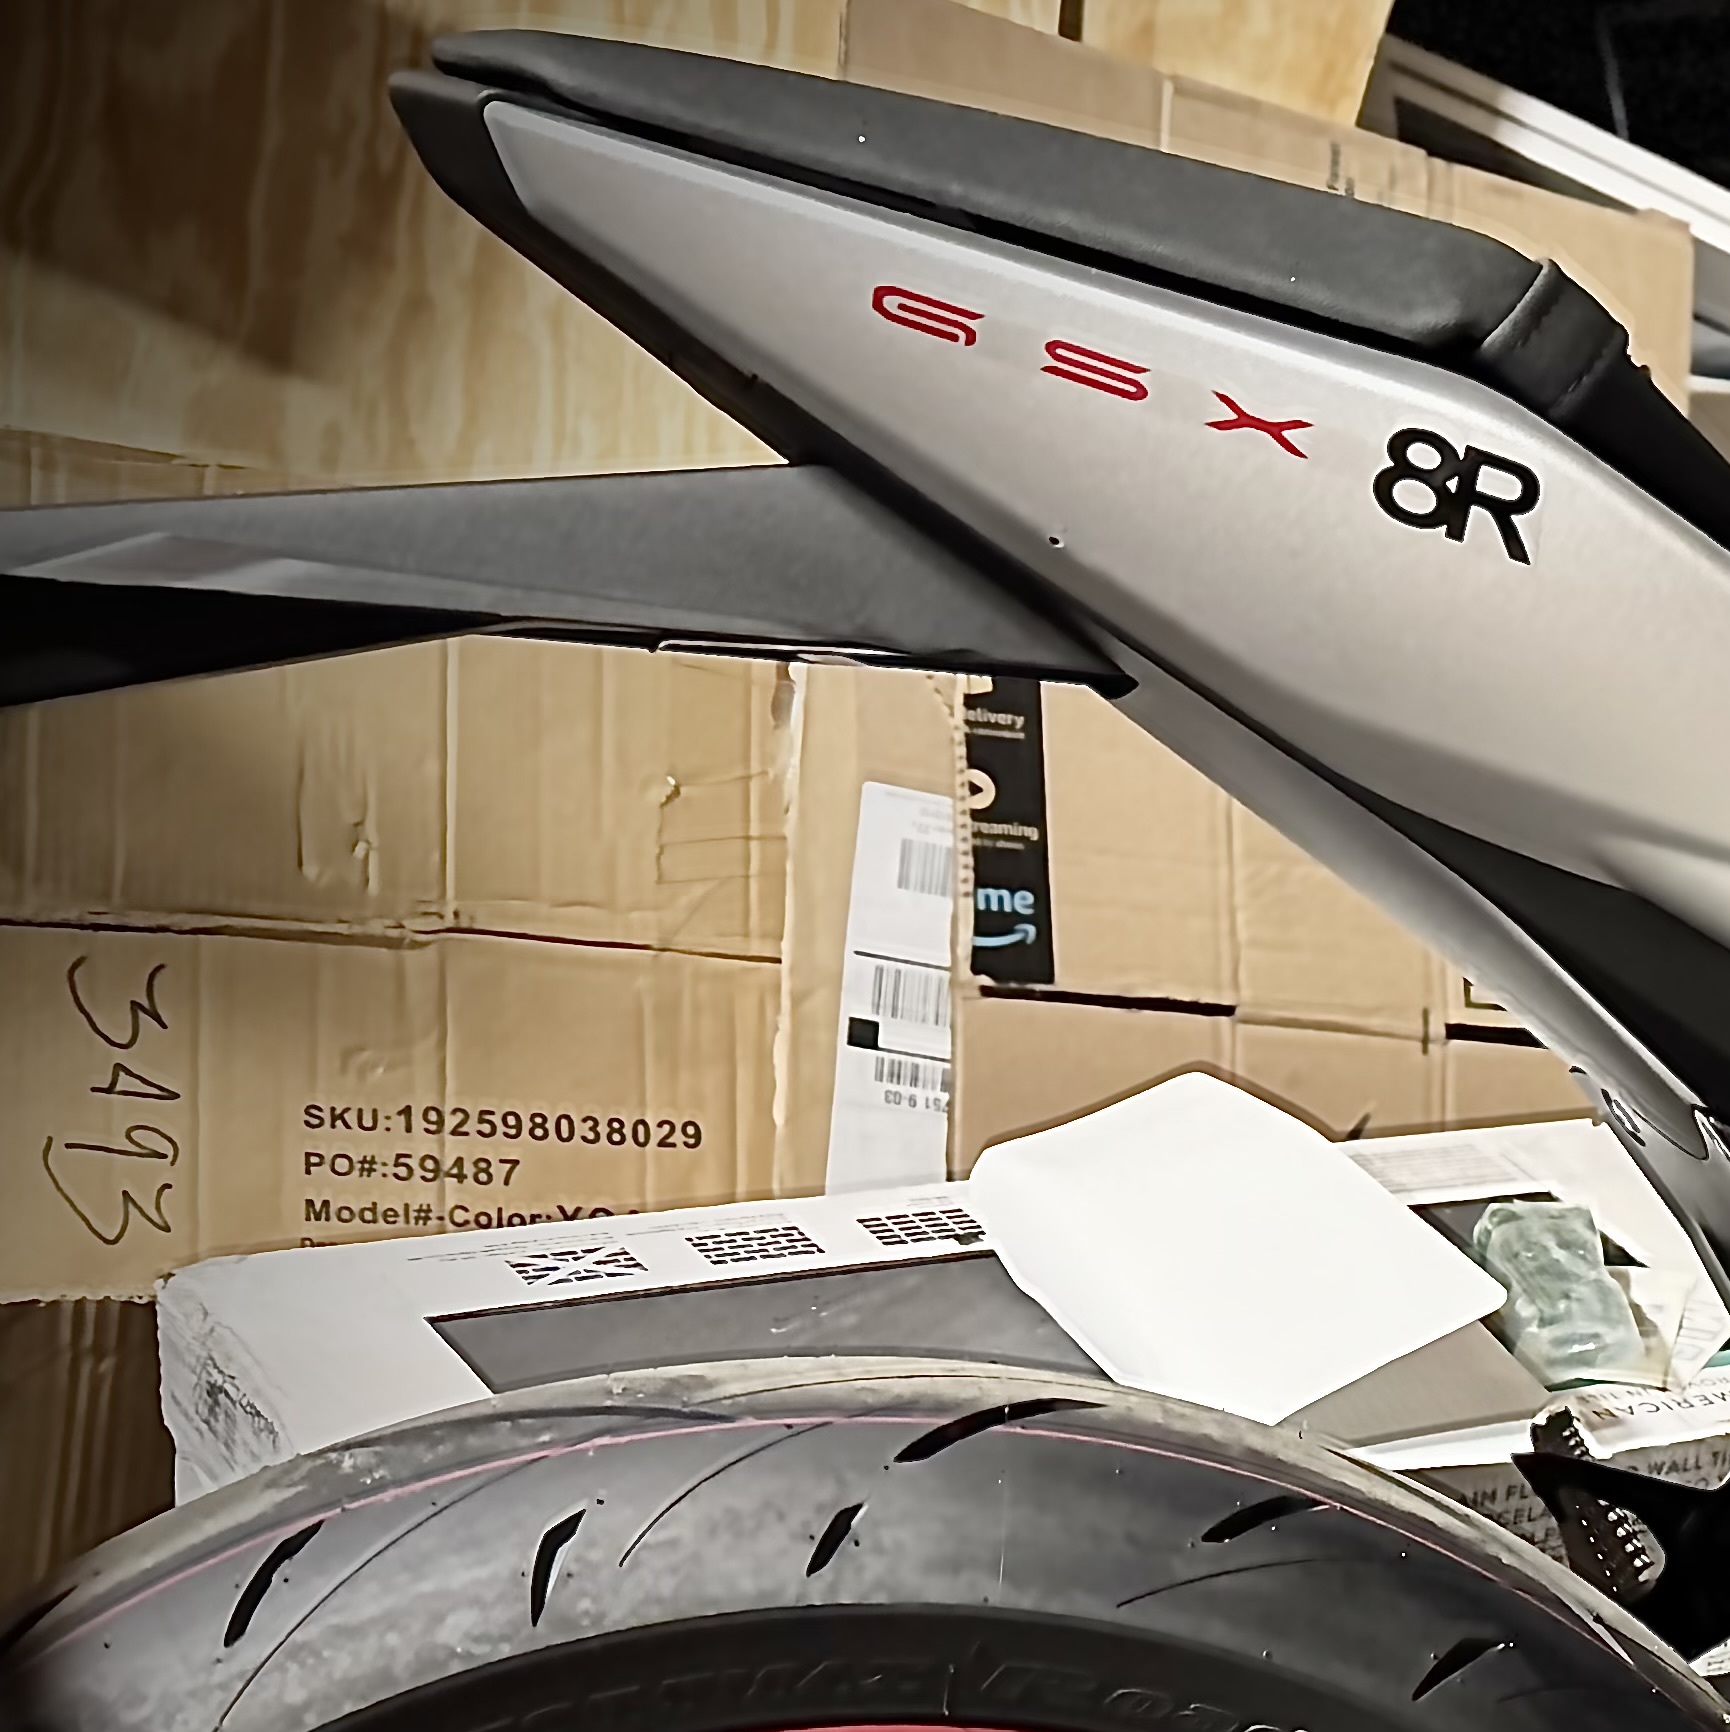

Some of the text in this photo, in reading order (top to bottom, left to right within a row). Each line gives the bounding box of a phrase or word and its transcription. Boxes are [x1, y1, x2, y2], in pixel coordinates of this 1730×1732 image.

[872, 286, 1540, 565] GSX 8R
[964, 707, 1025, 729] elivery
[971, 821, 1039, 841] reaming
[42, 955, 181, 1246] 3493
[303, 1103, 703, 1149] SKU:192598038029
[304, 1152, 521, 1187] PO#:59487
[1647, 1456, 1702, 1475] WALL
